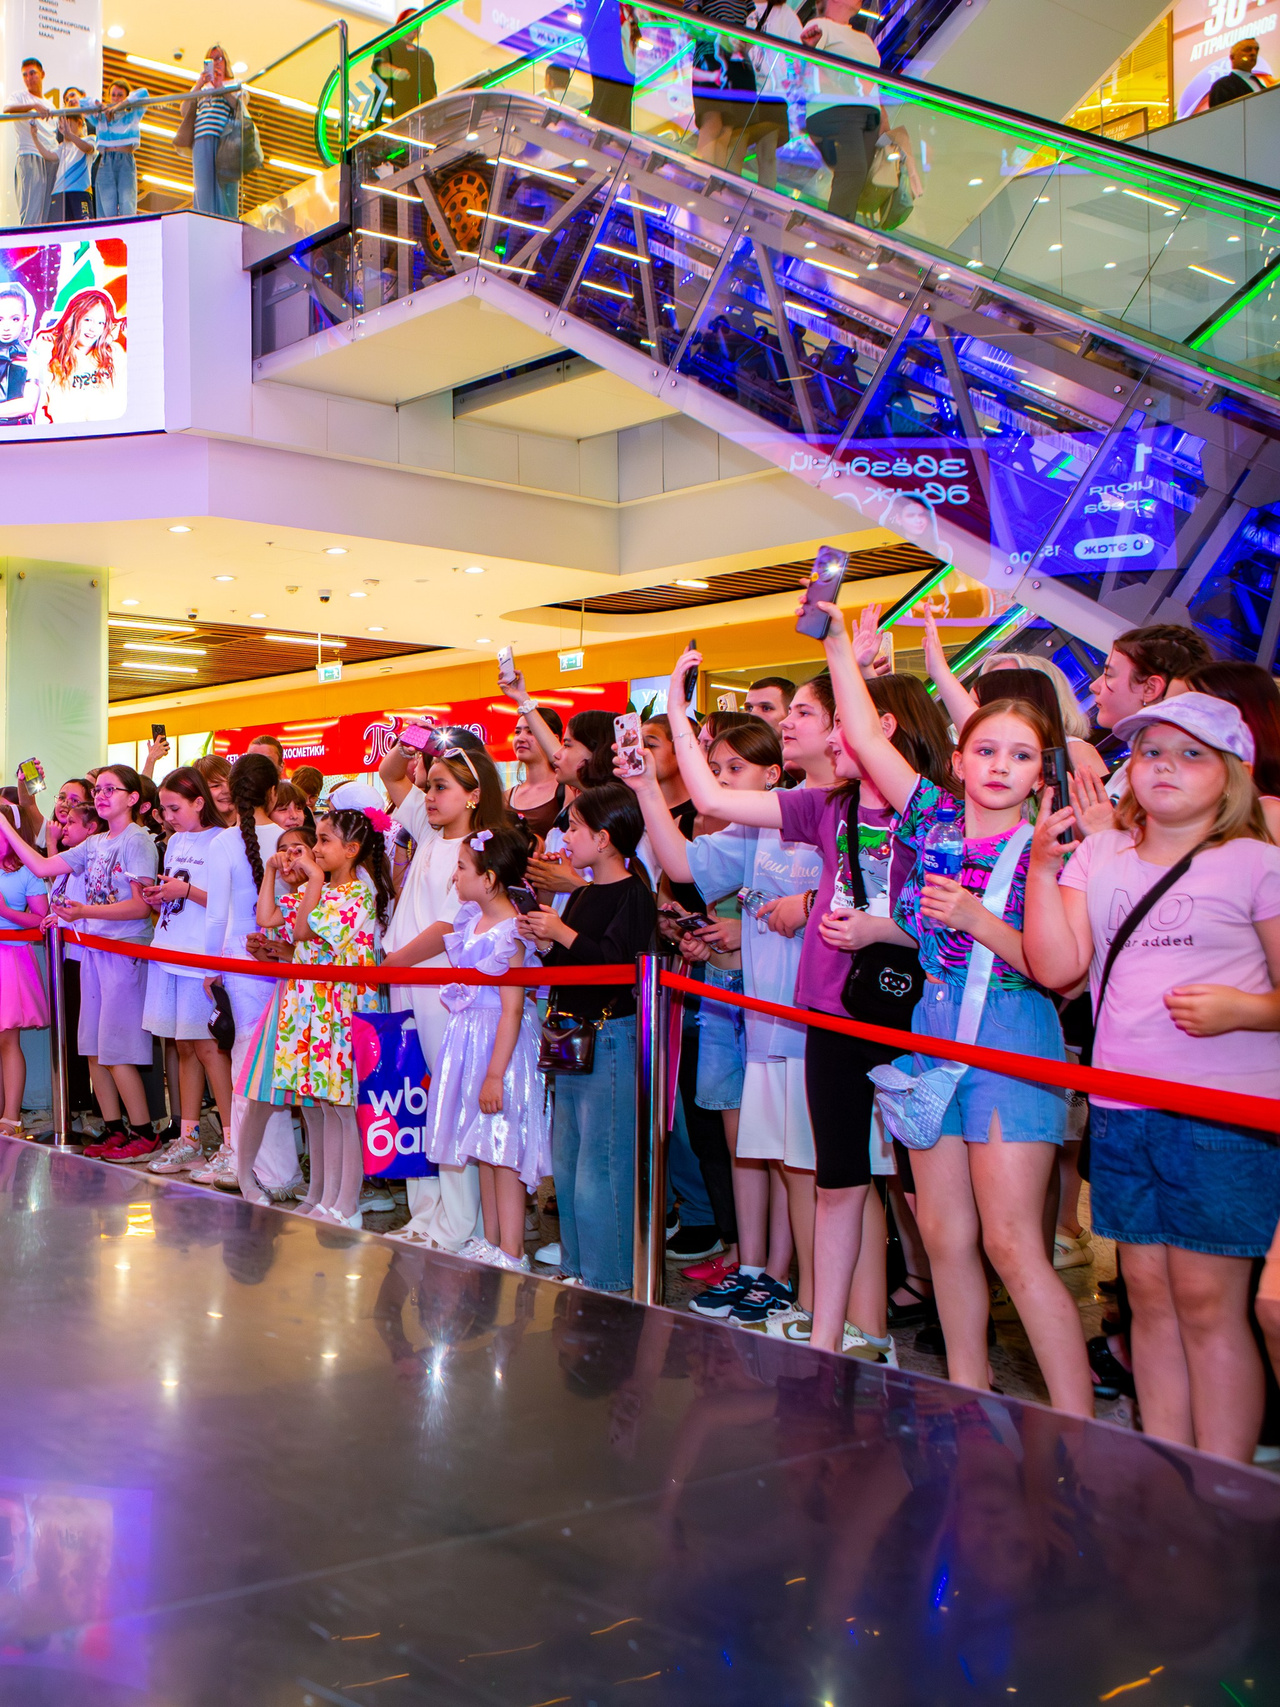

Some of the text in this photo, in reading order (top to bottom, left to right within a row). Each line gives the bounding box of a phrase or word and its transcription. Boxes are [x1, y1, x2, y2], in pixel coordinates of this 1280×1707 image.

[1190, 13, 1277, 62] АТТРАКЦИОНОВ
[283, 745, 325, 759] КОСМЕТИКИ
[1108, 888, 1194, 932] NO
[1105, 934, 1194, 951] sar added
[367, 1076, 428, 1116] wb
